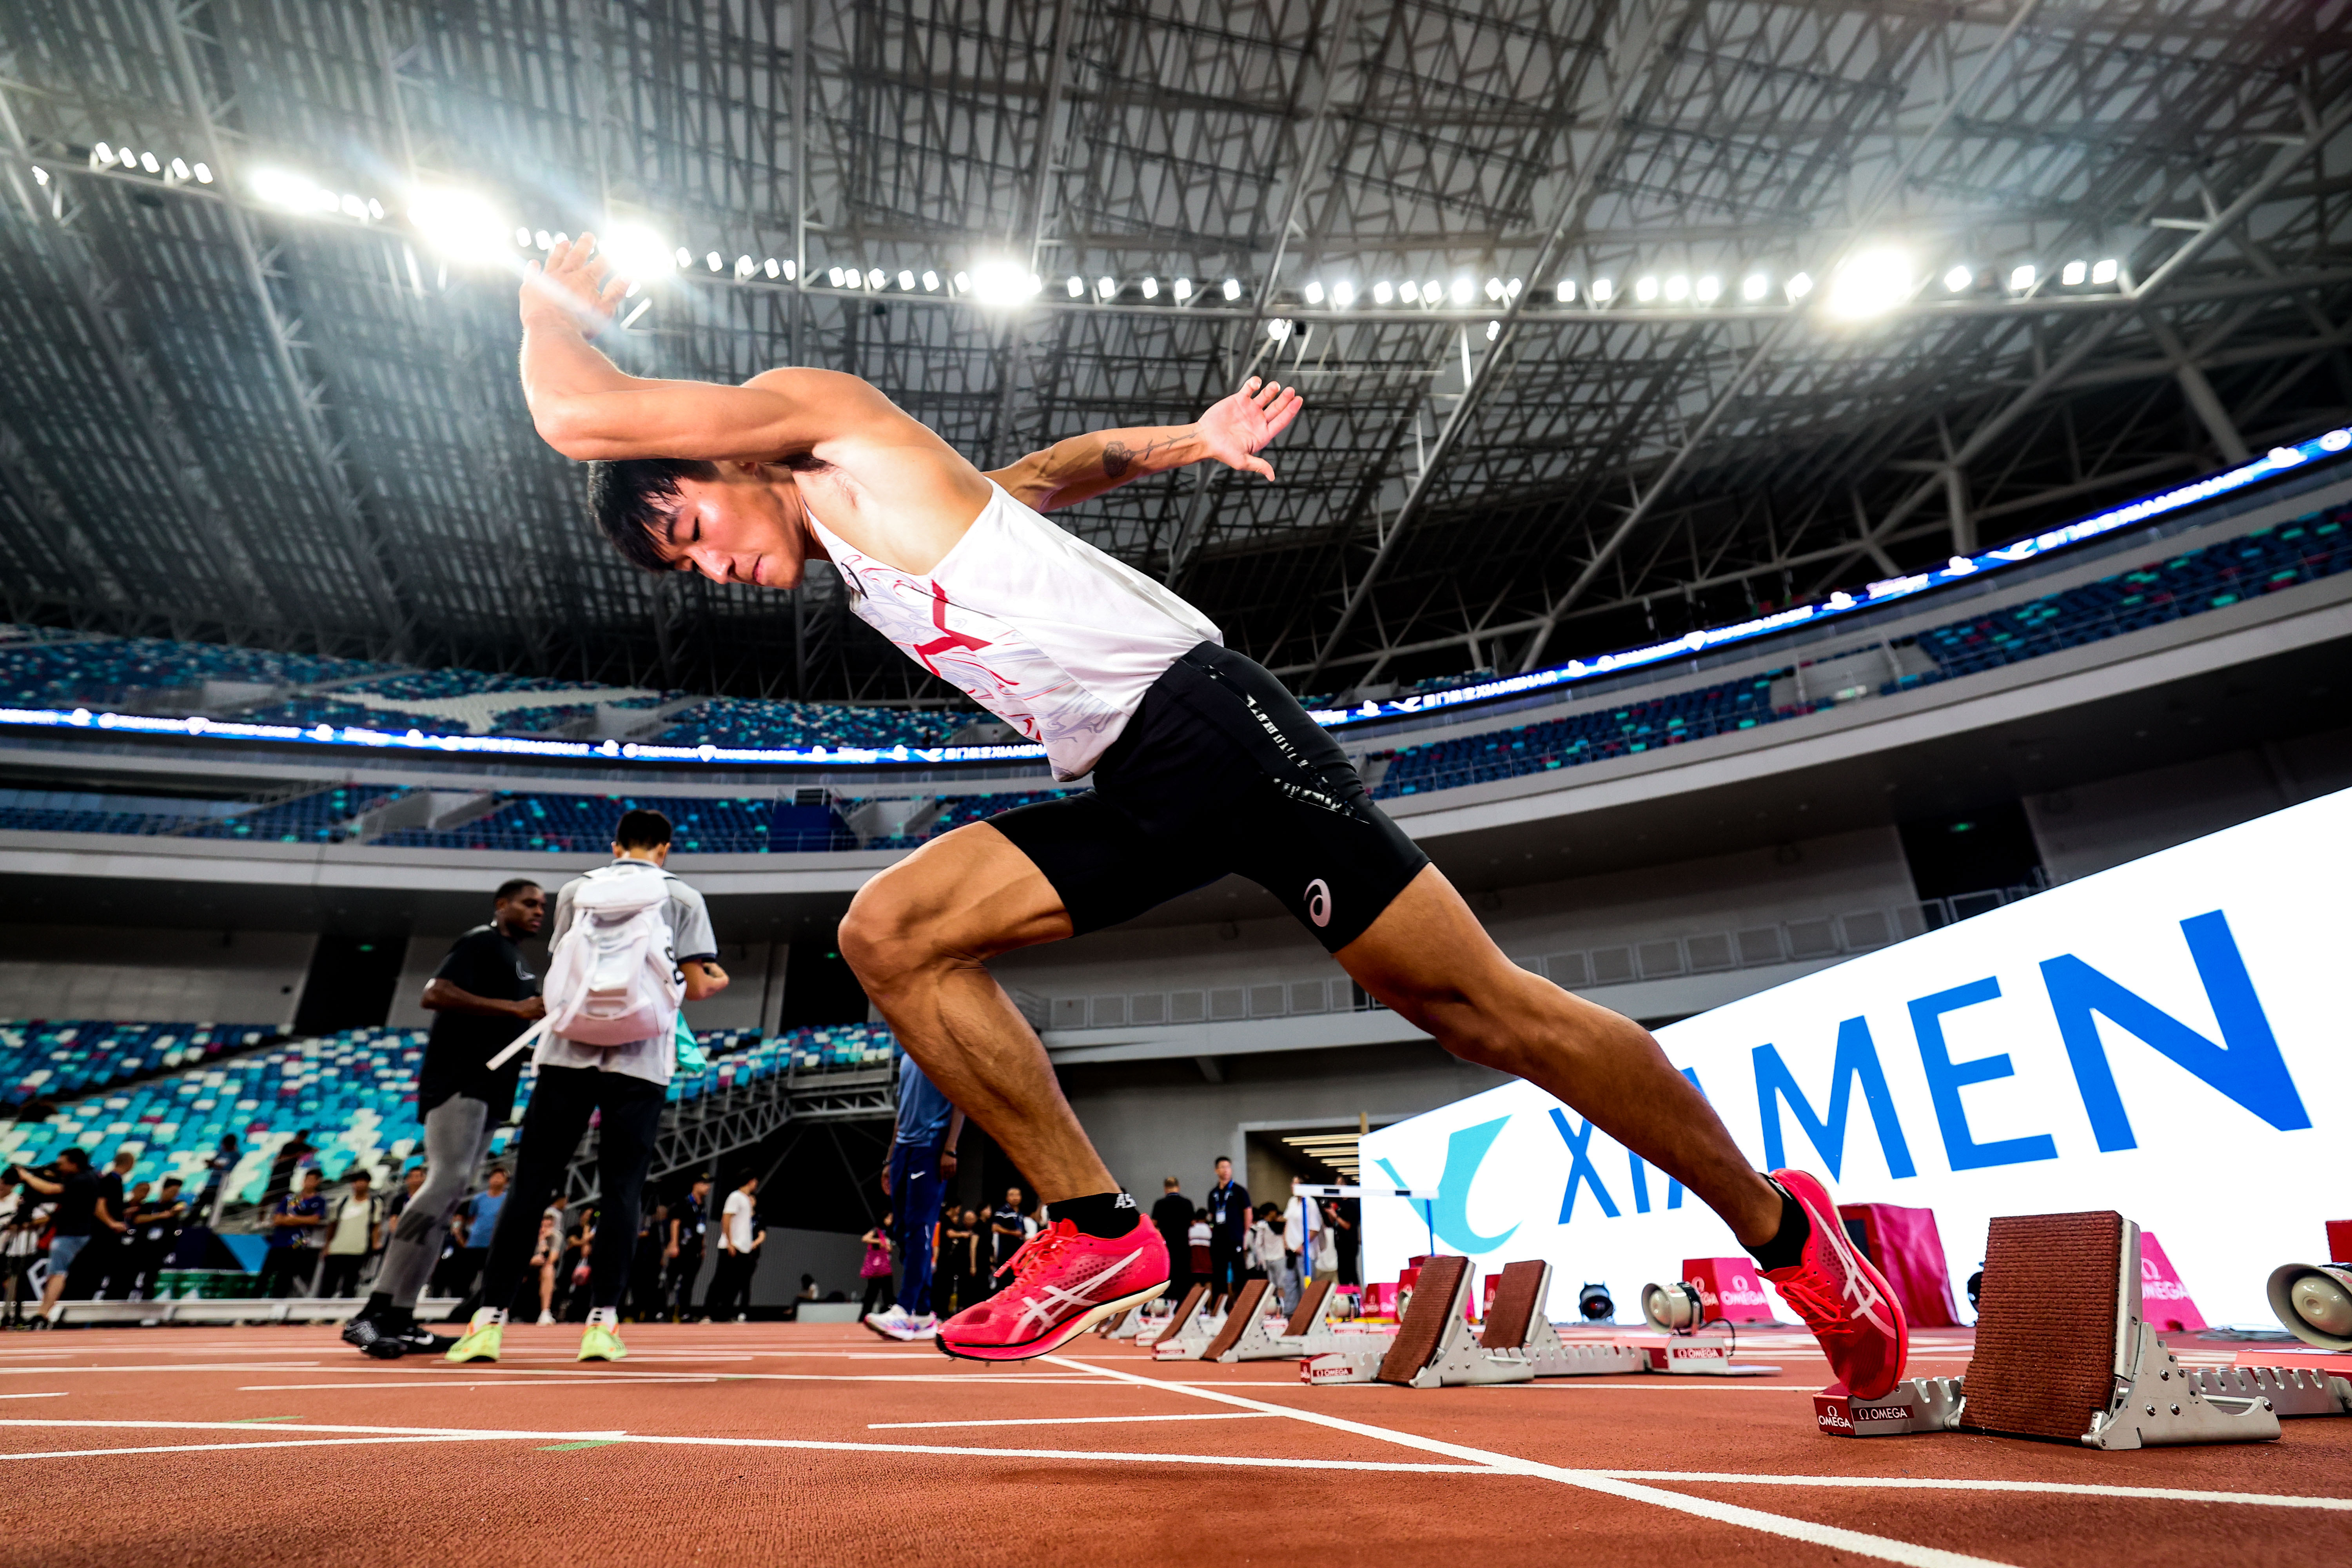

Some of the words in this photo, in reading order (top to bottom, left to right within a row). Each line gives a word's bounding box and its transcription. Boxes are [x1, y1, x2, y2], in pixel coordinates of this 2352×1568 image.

[1720, 1290, 1768, 1306] OMEGA
[1689, 1348, 1720, 1359] OMEGA
[1325, 1368, 1349, 1376] OMEGA
[1871, 1407, 1908, 1419] OMEGA
[1818, 1415, 1852, 1429] OMEGA
